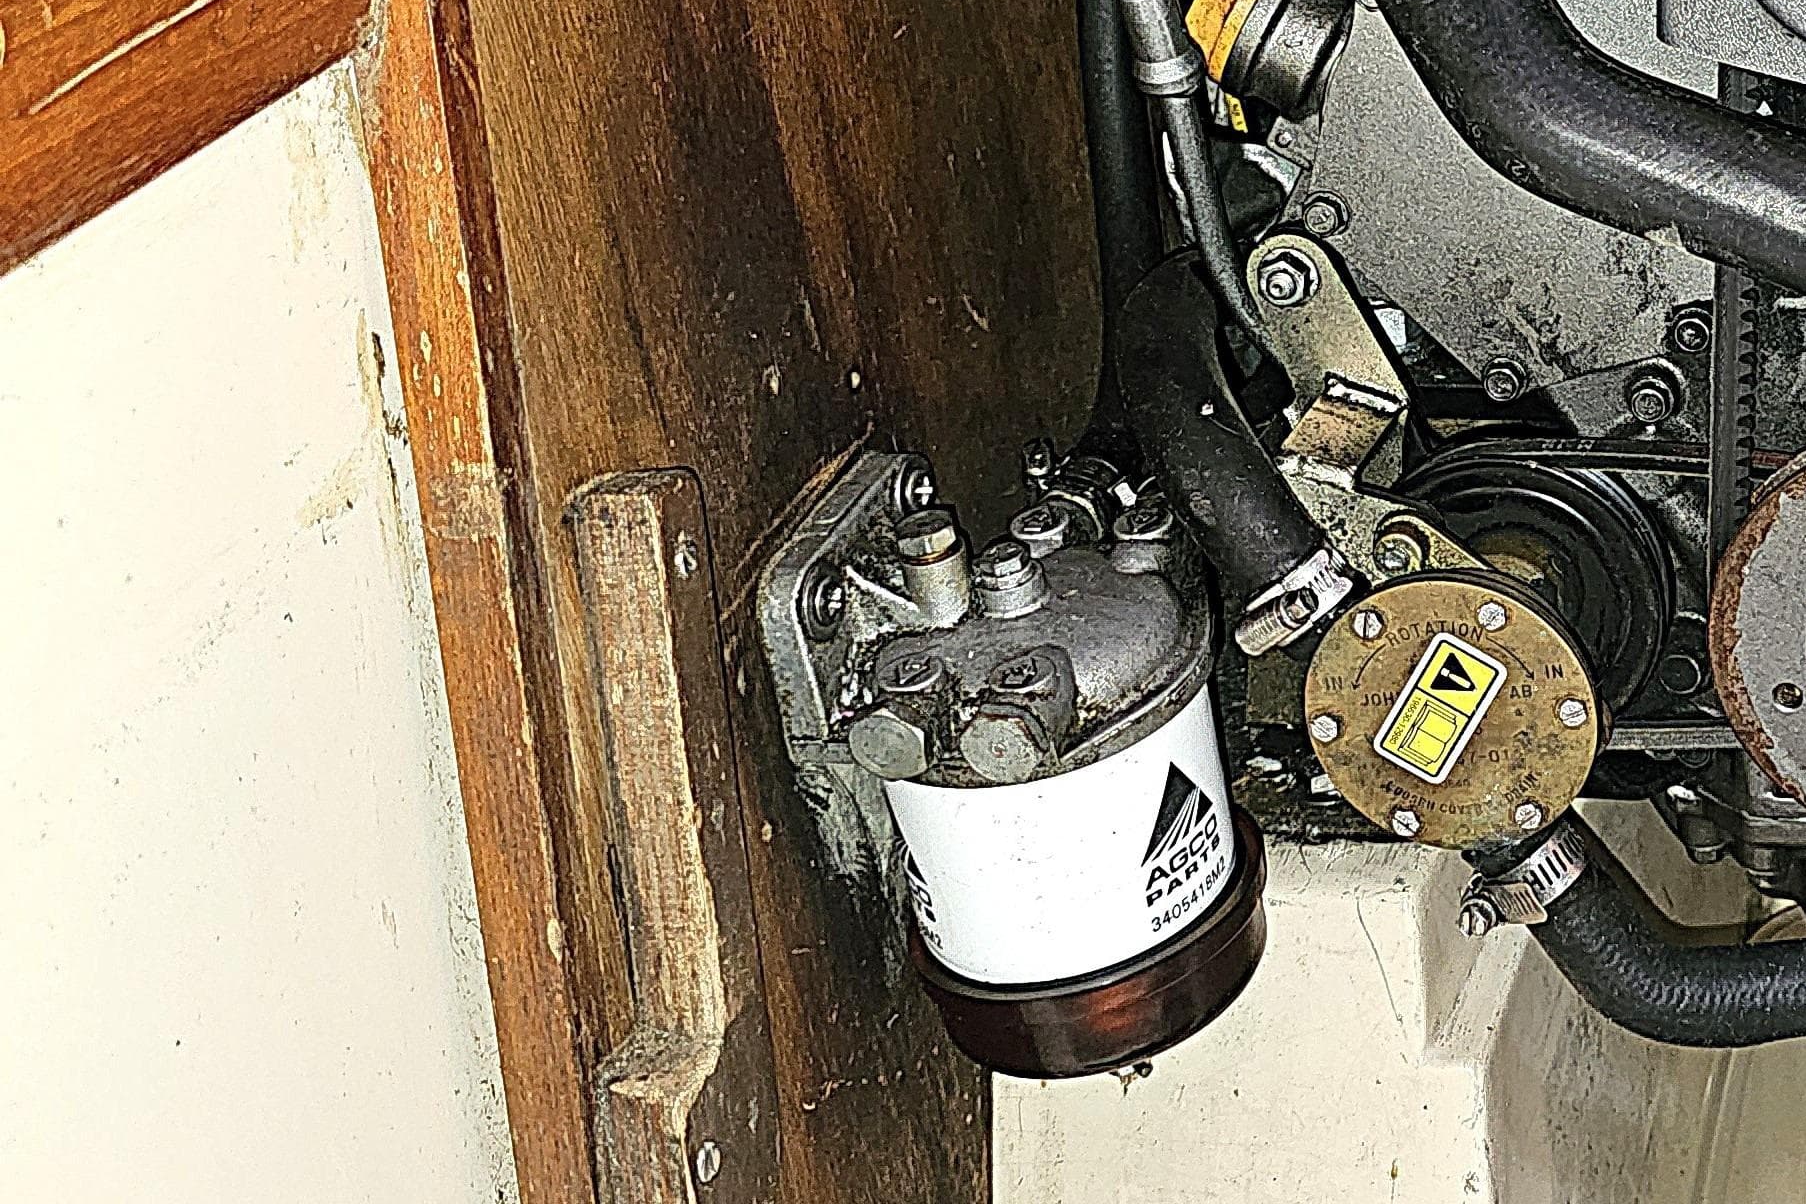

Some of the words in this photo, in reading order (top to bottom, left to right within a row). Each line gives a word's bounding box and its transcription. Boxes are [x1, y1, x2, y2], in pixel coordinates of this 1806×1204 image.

[1385, 620, 1483, 647] ROTATION
[1325, 675, 1343, 691] IN
[1544, 663, 1564, 679] IN
[1361, 691, 1401, 707] JOH
[1510, 684, 1533, 699] AB
[1146, 812, 1218, 892] AGCO
[1146, 832, 1221, 908] PARTS
[1151, 855, 1226, 933] 3405418M2
